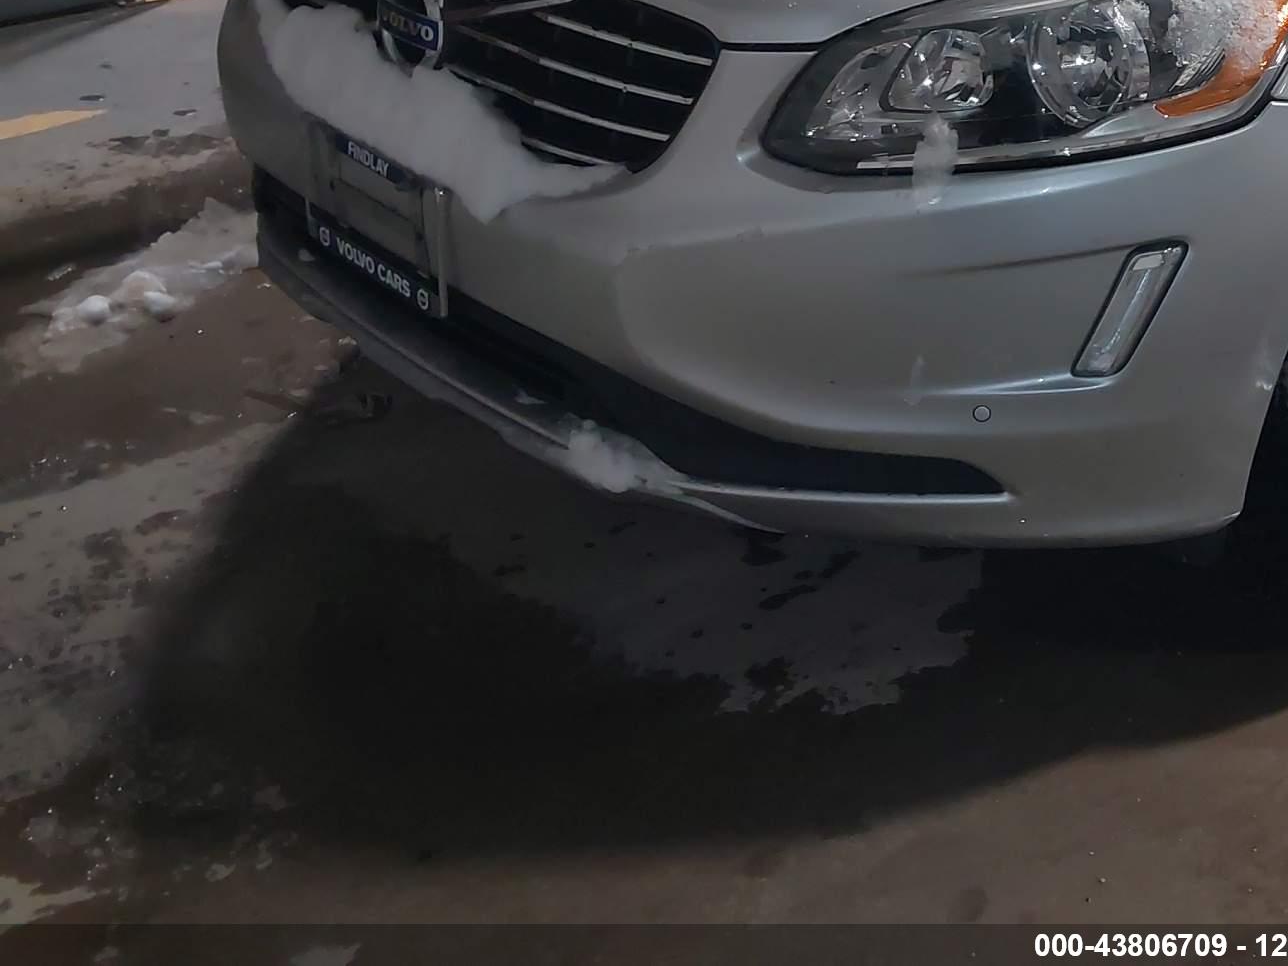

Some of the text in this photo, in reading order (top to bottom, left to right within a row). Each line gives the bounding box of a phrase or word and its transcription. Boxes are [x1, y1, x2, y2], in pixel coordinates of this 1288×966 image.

[382, 10, 434, 42] VOLVO
[347, 141, 391, 178] FINDLAY
[336, 237, 411, 298] VOLVO CARS
